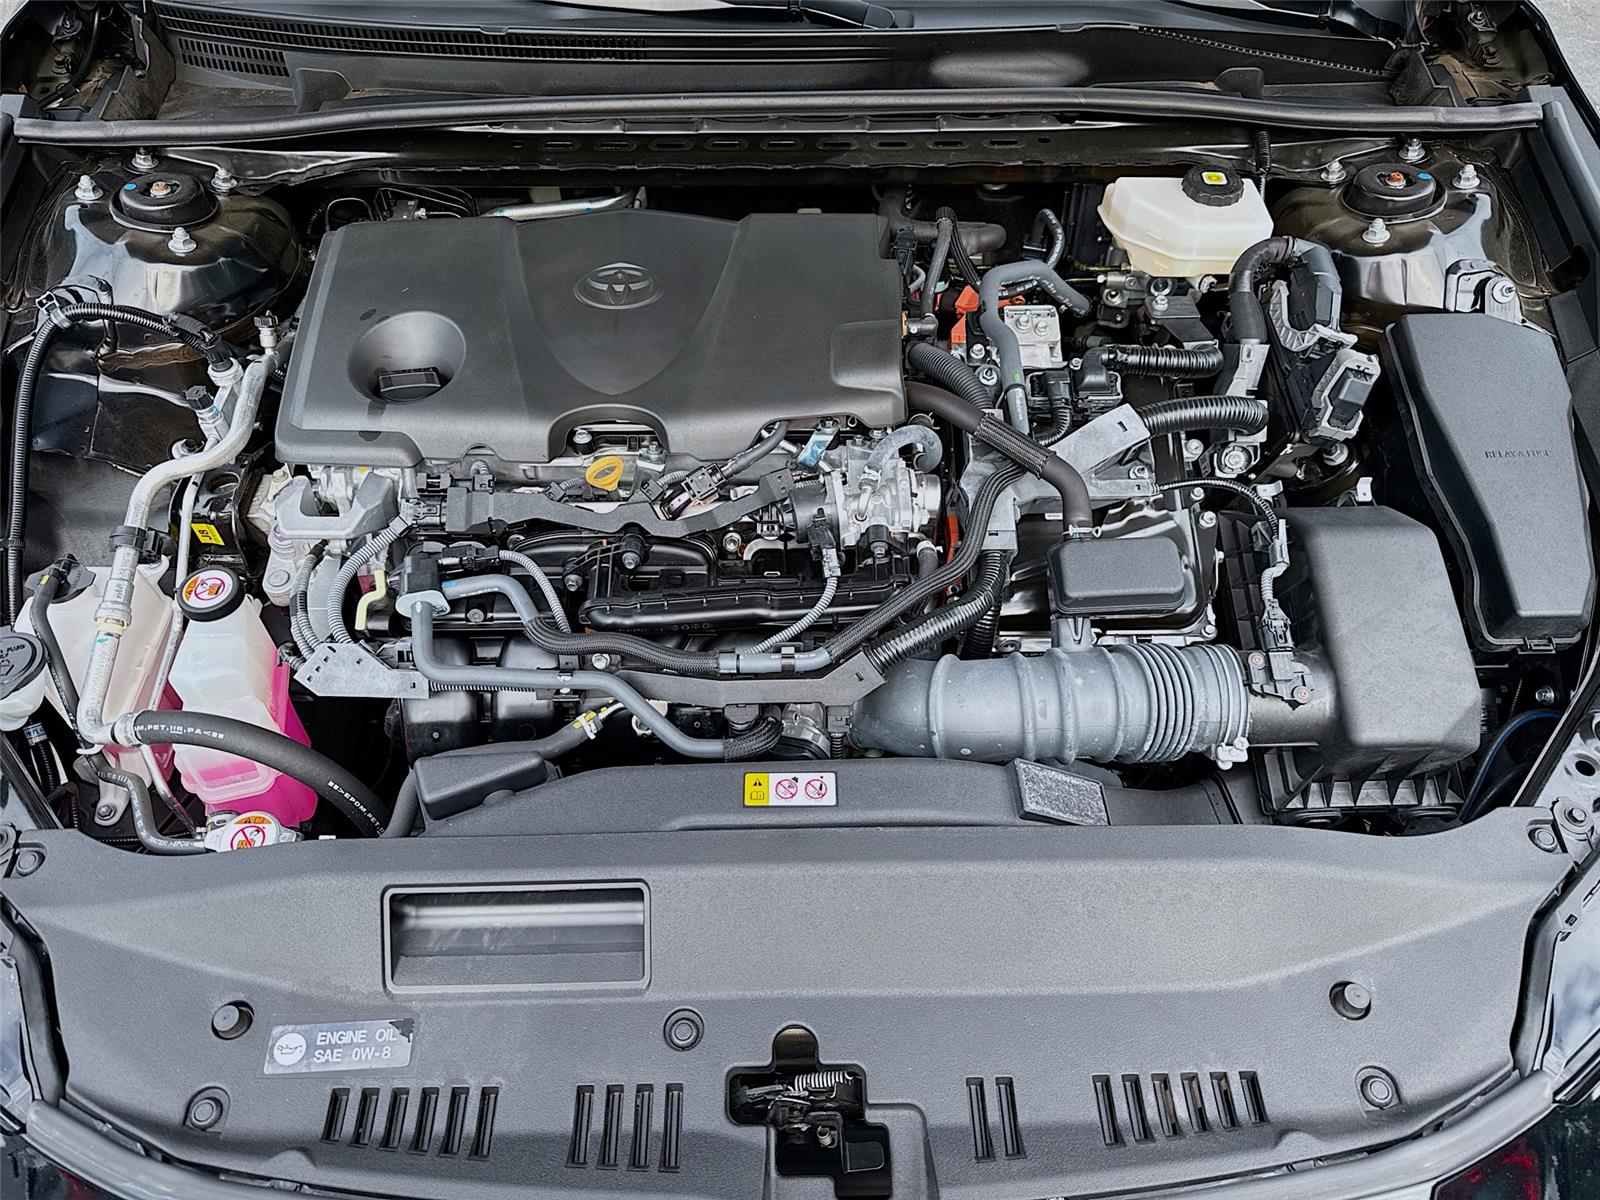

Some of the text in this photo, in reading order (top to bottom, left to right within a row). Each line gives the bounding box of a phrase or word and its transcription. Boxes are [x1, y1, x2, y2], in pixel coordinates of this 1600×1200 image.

[316, 1028, 397, 1046] ENGINE OIL
[313, 1046, 391, 1063] SAE 0W-8
